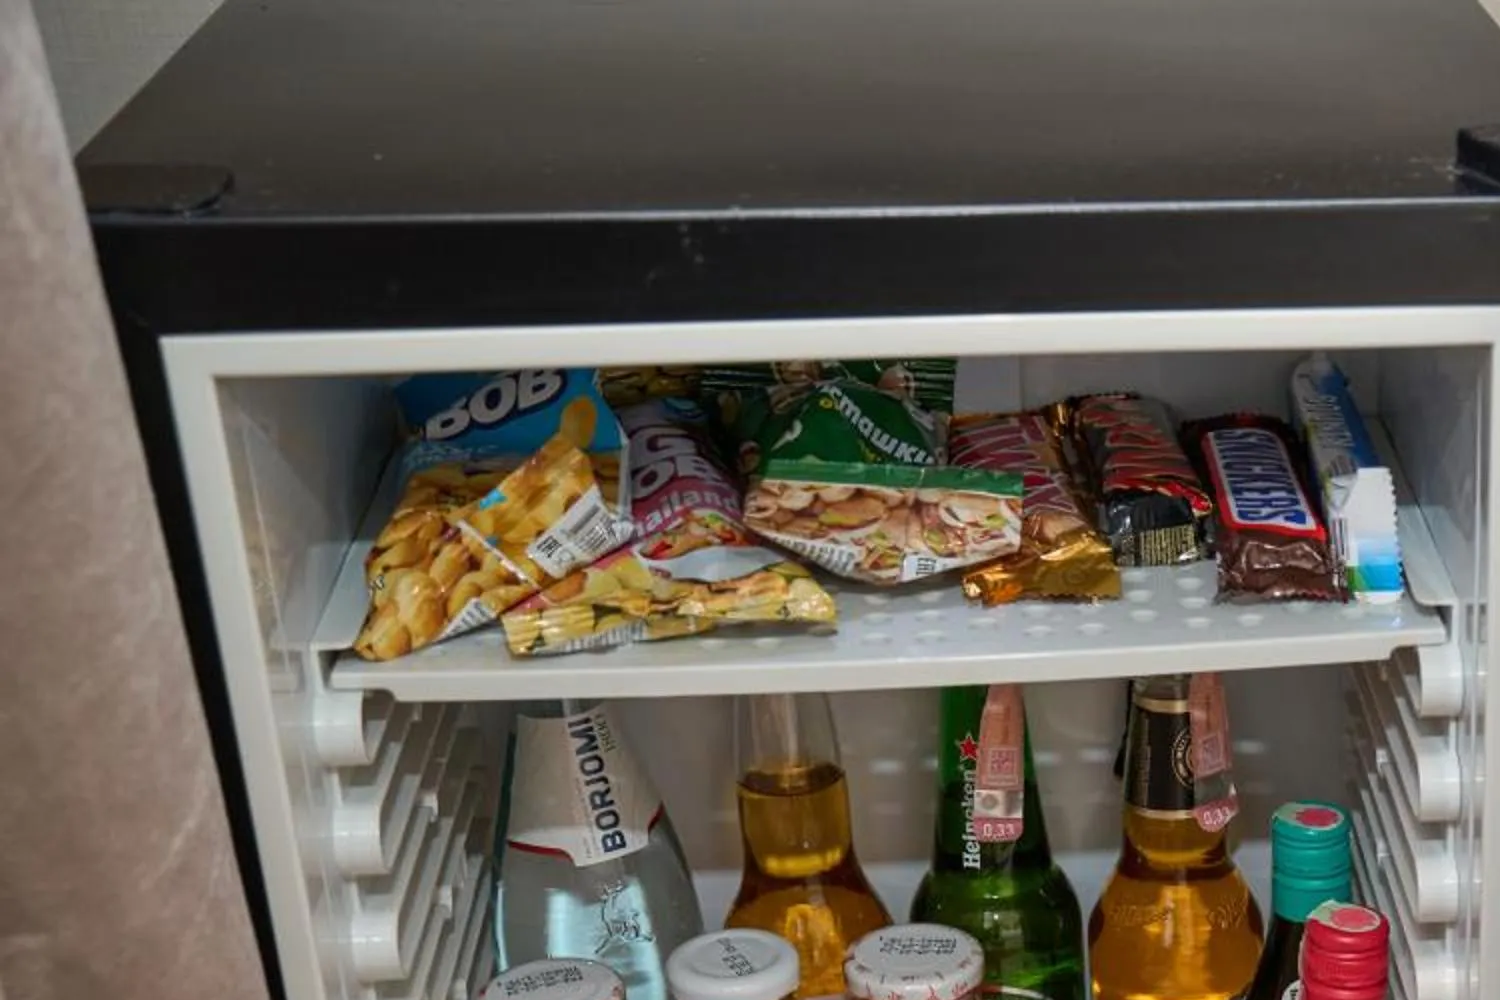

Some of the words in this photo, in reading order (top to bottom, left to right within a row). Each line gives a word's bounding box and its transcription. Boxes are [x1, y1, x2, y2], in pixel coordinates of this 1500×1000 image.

[824, 384, 935, 465] сташки
[1212, 428, 1308, 526] SNICKERS
[567, 716, 627, 853] BORJOMI
